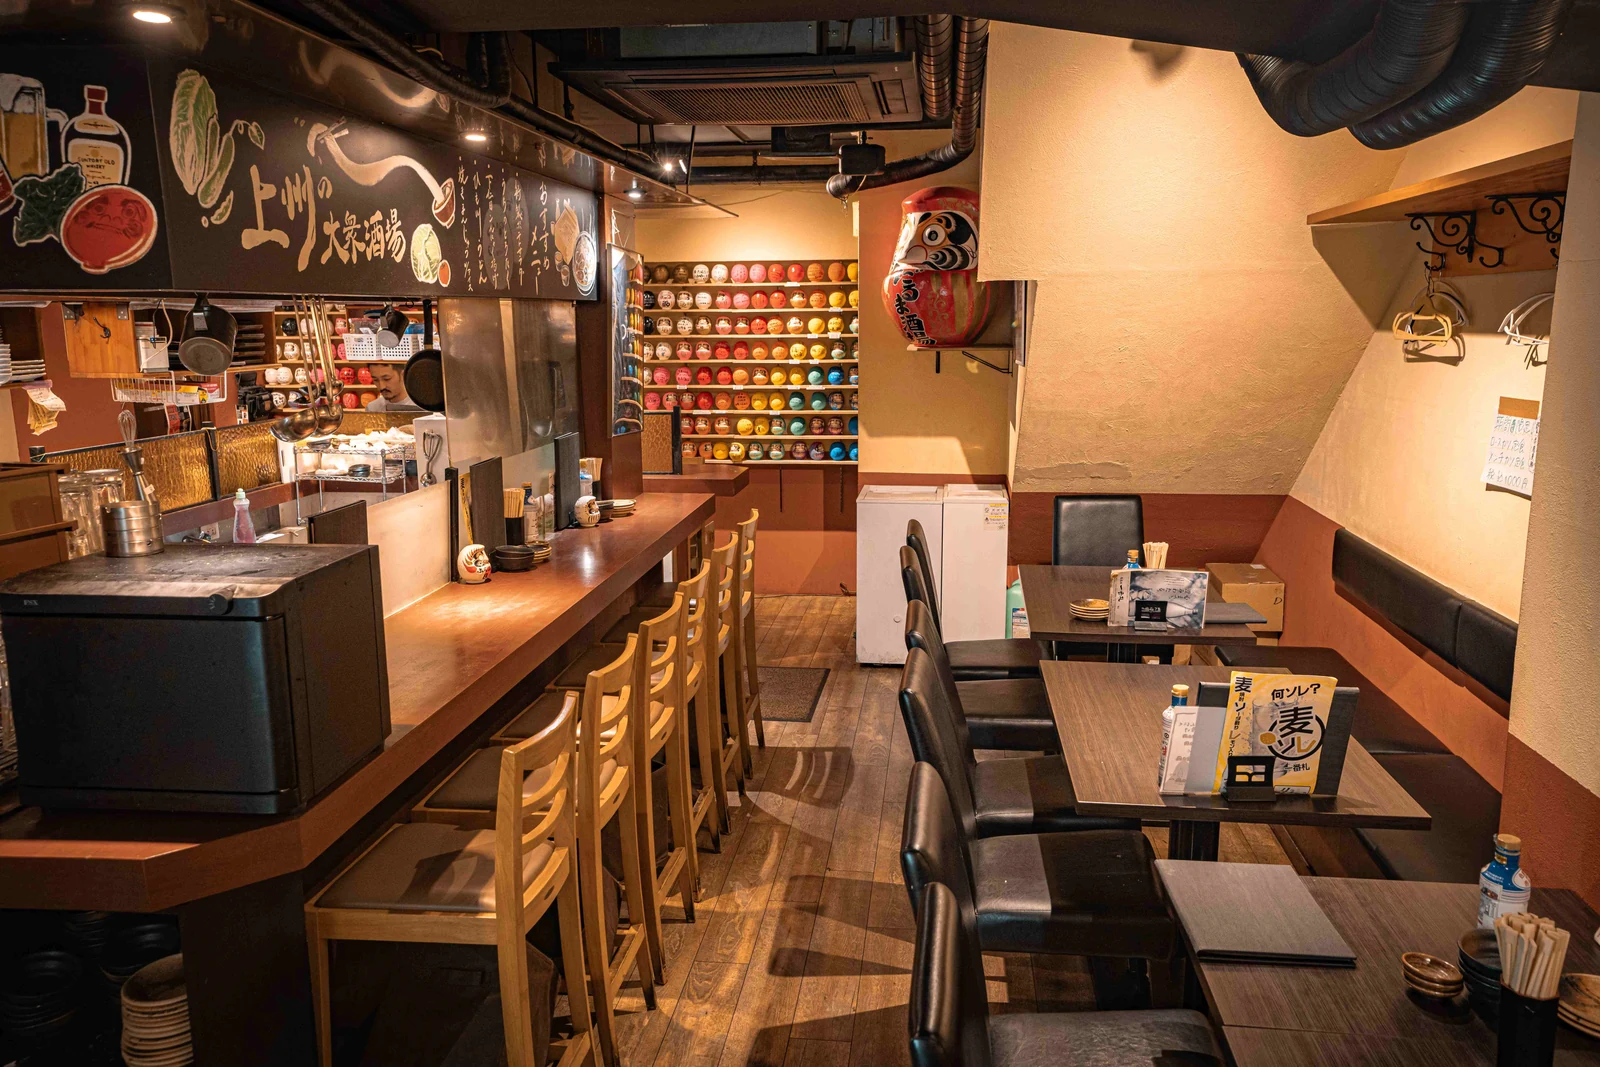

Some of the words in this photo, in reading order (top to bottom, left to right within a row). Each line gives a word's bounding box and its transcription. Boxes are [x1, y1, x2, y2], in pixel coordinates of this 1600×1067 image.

[241, 164, 333, 271] 上州の
[320, 208, 407, 266] 大衆酒場
